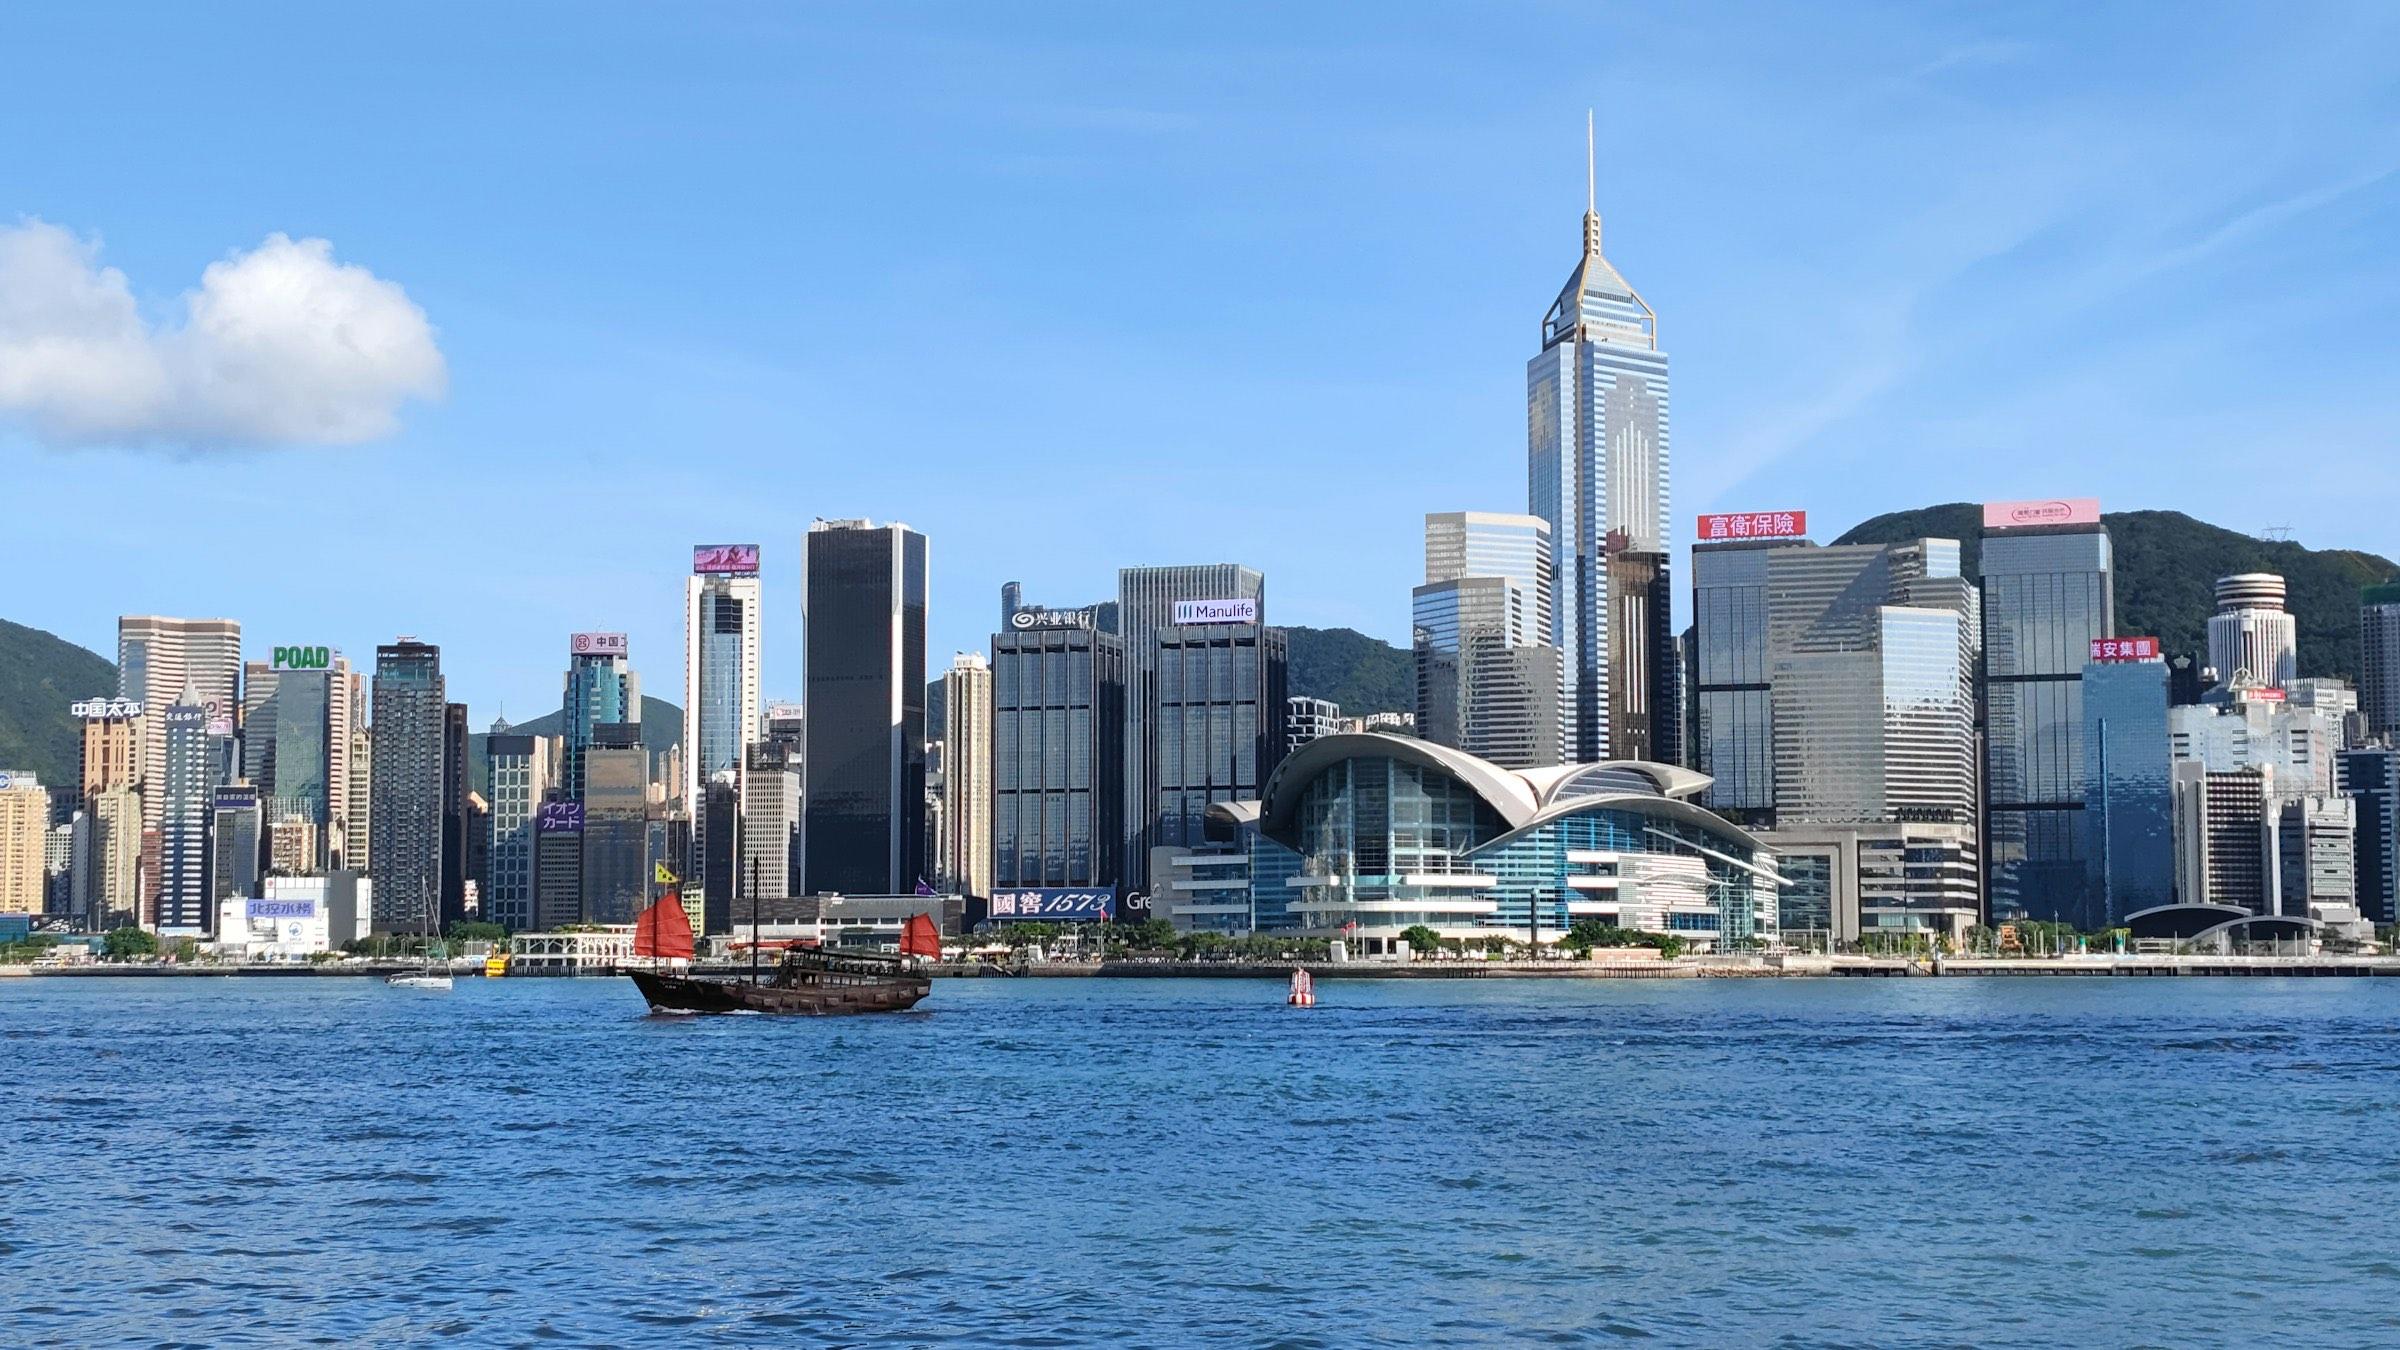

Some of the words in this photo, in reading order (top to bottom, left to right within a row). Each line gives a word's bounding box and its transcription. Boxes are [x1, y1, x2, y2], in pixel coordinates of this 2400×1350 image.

[1709, 513, 1795, 537] 富衛保險
[1196, 603, 1253, 618] Manulife
[1035, 611, 1091, 627] 兴业银行
[273, 646, 330, 669] POAD
[71, 702, 141, 718] 中国太平
[543, 802, 580, 815] イオン
[543, 816, 580, 829] カード
